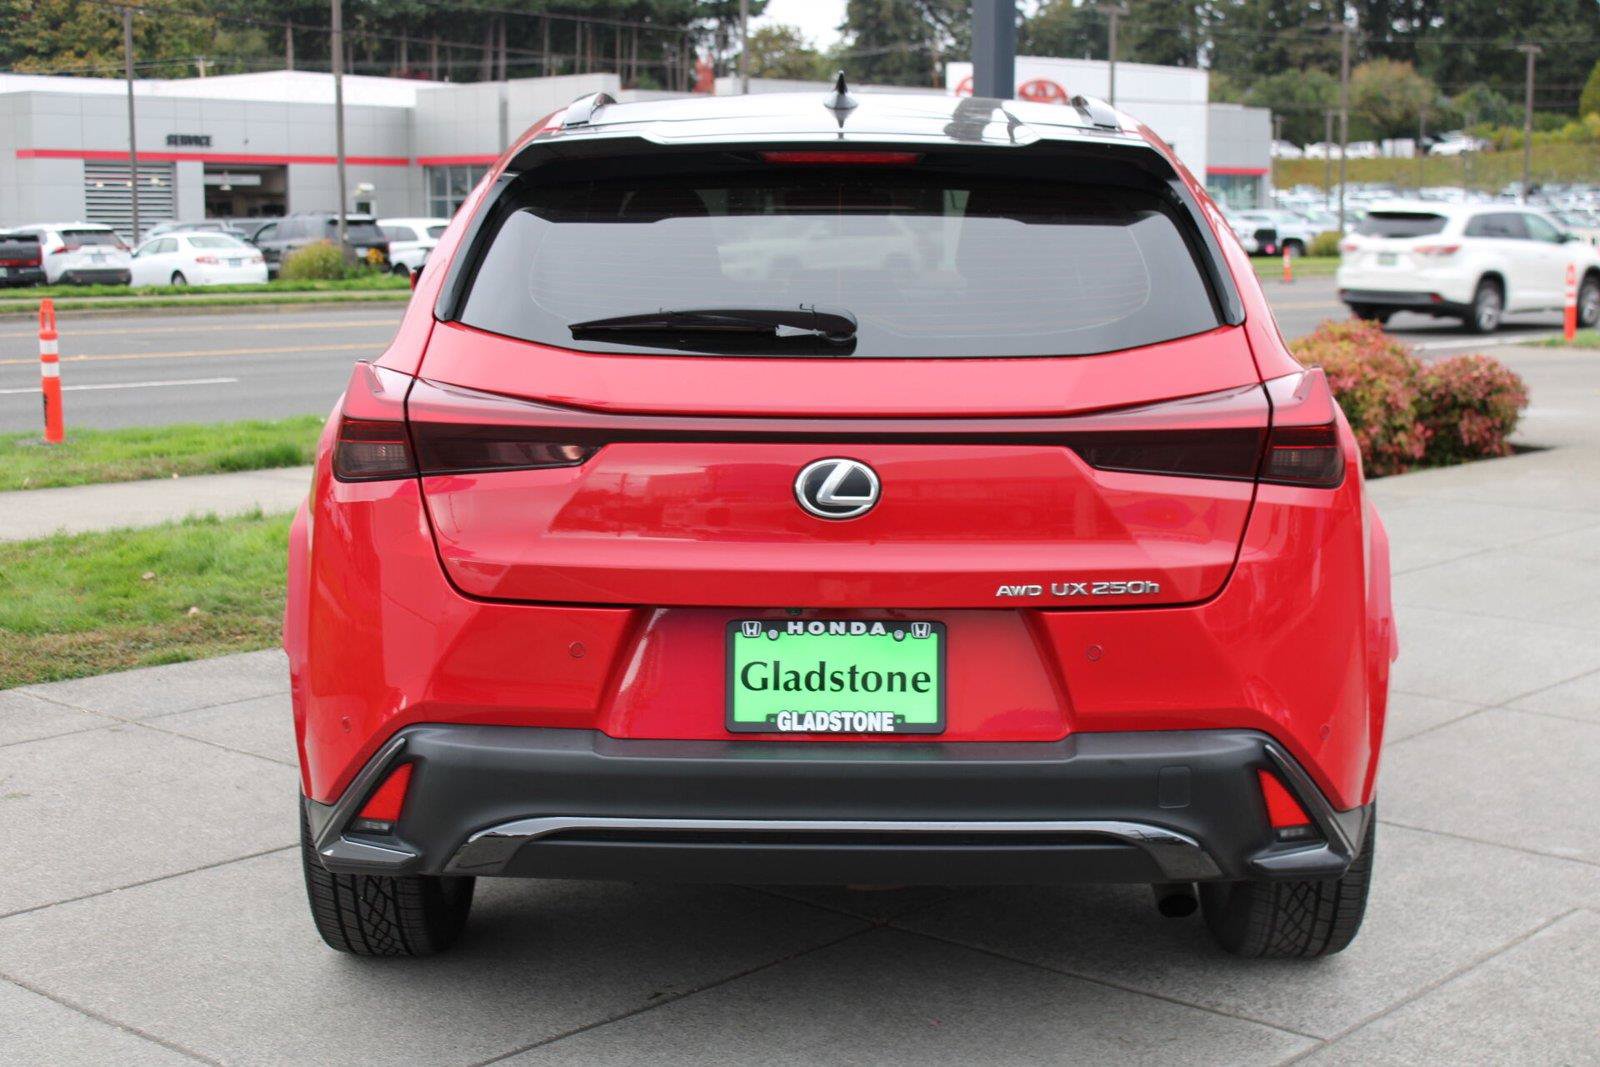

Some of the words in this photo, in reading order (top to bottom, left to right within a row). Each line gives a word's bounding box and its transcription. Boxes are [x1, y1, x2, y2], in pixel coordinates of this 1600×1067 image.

[996, 585, 1042, 597] AWD
[1052, 582, 1088, 596] UX
[1092, 580, 1159, 595] 250h
[787, 621, 886, 636] HONDA
[740, 660, 931, 692] Gladstone
[776, 711, 895, 732] GLADSTONE
